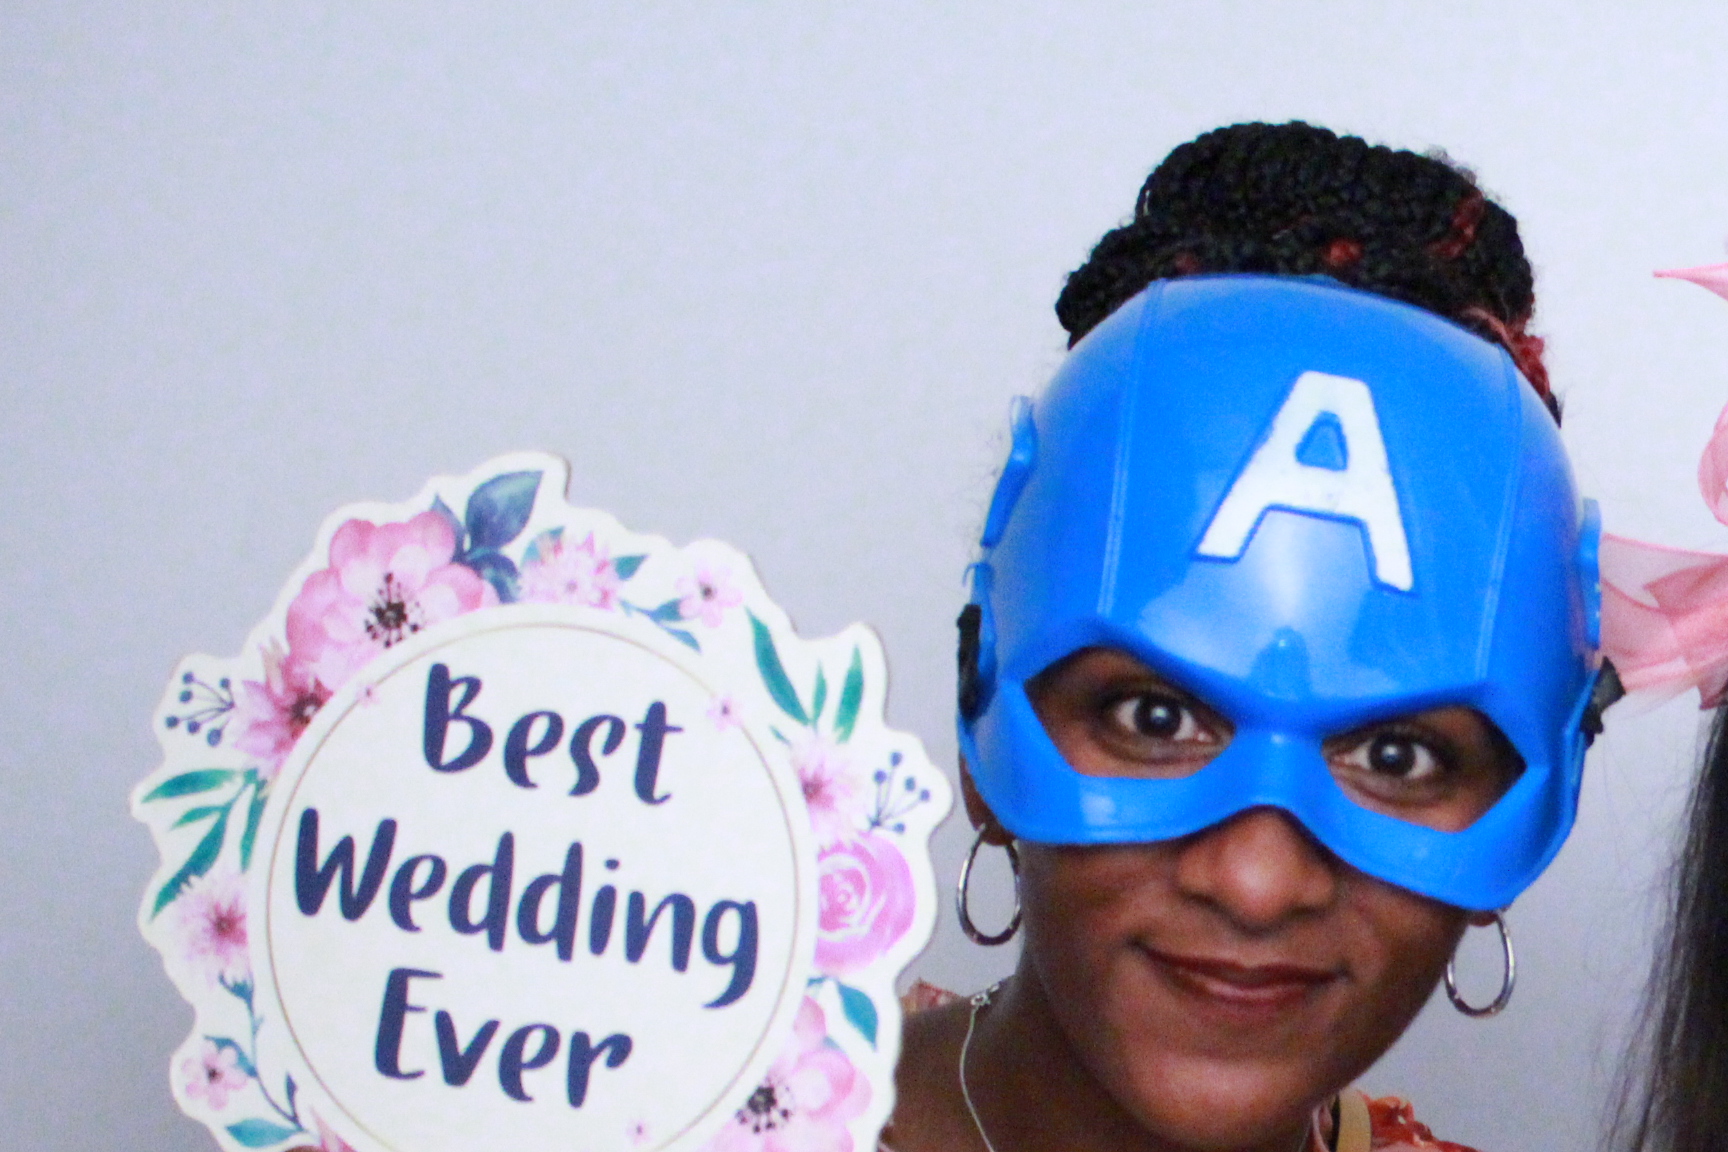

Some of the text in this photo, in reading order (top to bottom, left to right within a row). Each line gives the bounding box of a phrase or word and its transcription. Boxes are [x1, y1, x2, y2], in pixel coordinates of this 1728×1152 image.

[1197, 370, 1414, 593] A
[421, 662, 684, 806] Best
[292, 806, 760, 1009] Wedding
[372, 966, 634, 1109] Ever
